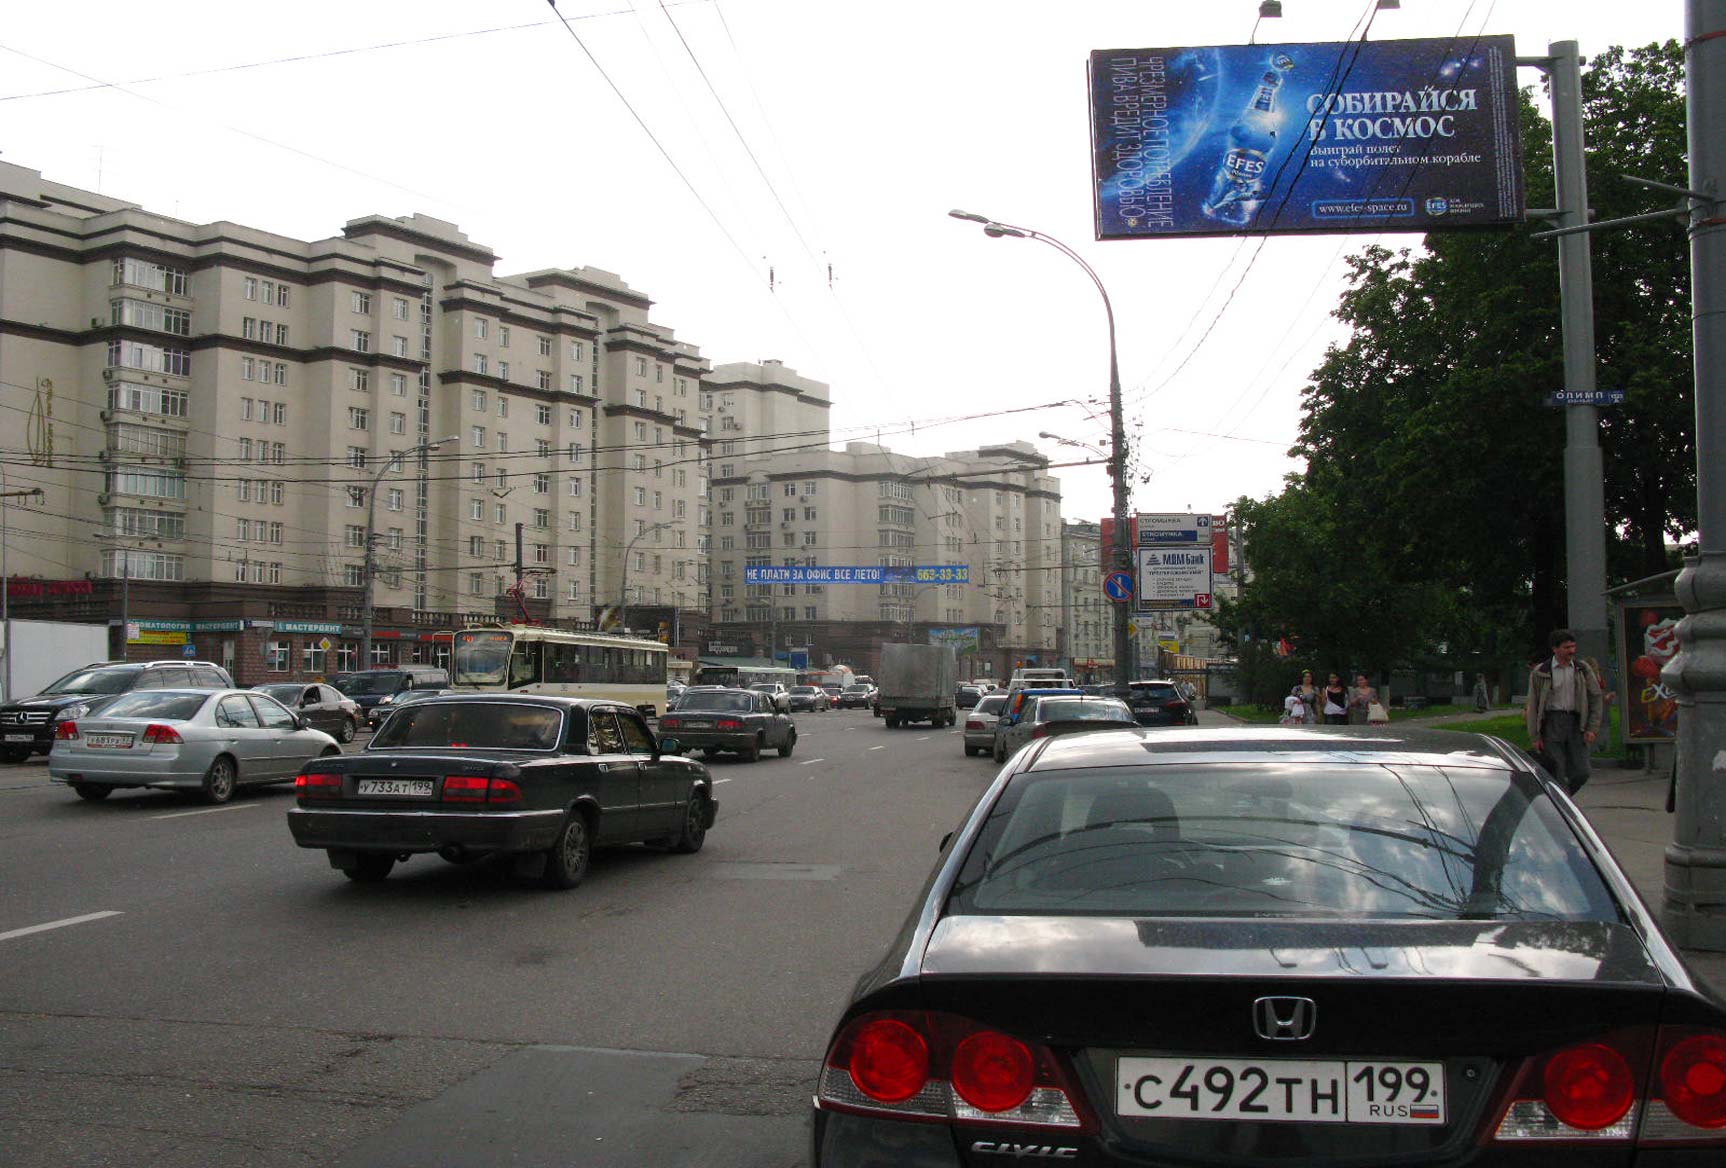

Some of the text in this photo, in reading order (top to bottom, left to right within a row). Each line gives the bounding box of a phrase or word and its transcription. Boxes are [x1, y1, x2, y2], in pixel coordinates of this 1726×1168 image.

[1306, 85, 1478, 115] СОБИРАЙСЯ
[1110, 57, 1146, 219] ПИВА ВРЕДИТ ЗДОРОВЬЮ
[1309, 115, 1455, 141] В КОСМОС
[1139, 56, 1174, 228] ЧРЕЗМЕРНОЕ ПОТРЕБЛЕНИЕ
[1227, 154, 1264, 174] EFES
[1311, 159, 1325, 168] на
[1432, 151, 1481, 165] корабле
[747, 569, 880, 580] НЕ ПЛАТИ ЗА ОФИС ВСЕ ЛЕТО!
[363, 781, 430, 793] У733АТ 199
[1134, 1065, 1431, 1114] С492ТН 199
[1370, 1104, 1408, 1117] RUS
[971, 1141, 1078, 1160] CIVIC
